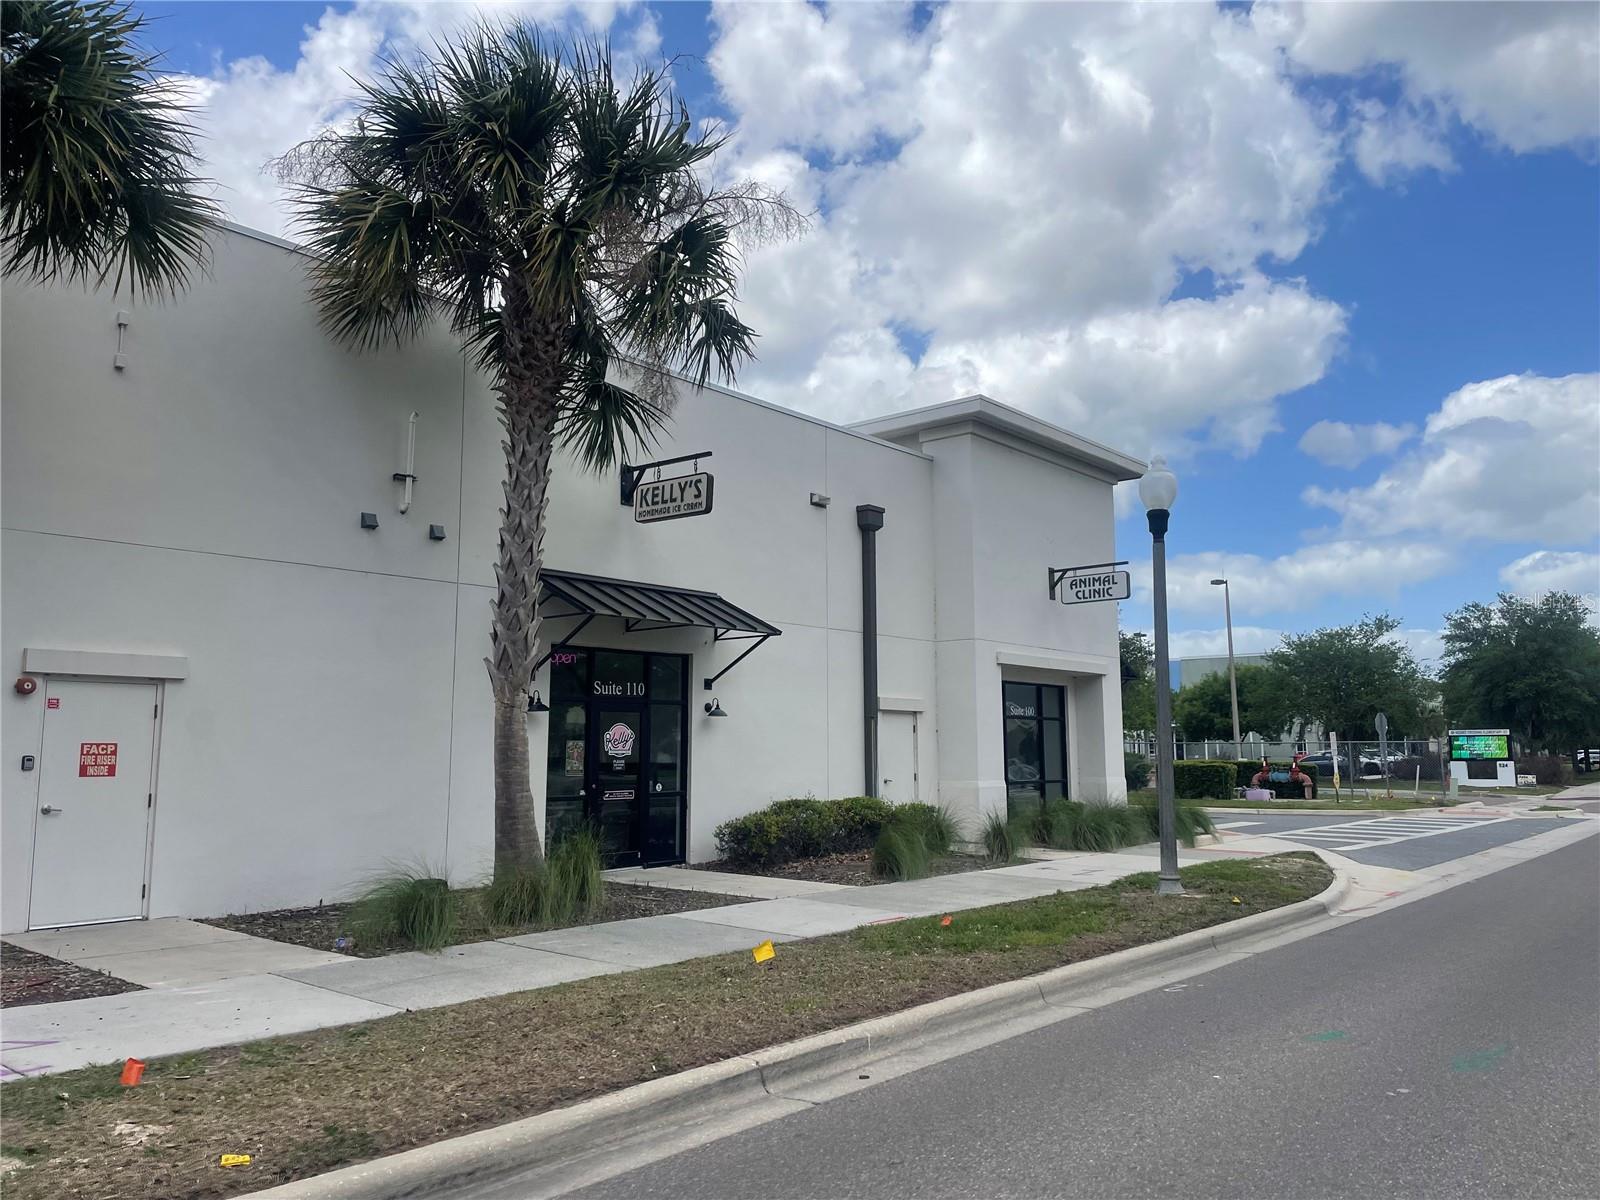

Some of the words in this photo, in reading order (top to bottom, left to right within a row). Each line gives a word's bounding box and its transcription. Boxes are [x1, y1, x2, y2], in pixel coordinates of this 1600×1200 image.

[640, 479, 702, 508] KELLY'S
[638, 505, 670, 518] HOMEMADE
[672, 504, 681, 512] ICE
[683, 501, 703, 510] CREAM
[1070, 574, 1118, 590] ANIMAL
[1075, 587, 1113, 600] CLINIC
[593, 680, 623, 695] Suite
[627, 682, 645, 696] 110
[83, 744, 116, 754] FACP
[81, 755, 96, 765] FIRE
[97, 755, 116, 765] RISER
[87, 766, 109, 776] INSIDE
